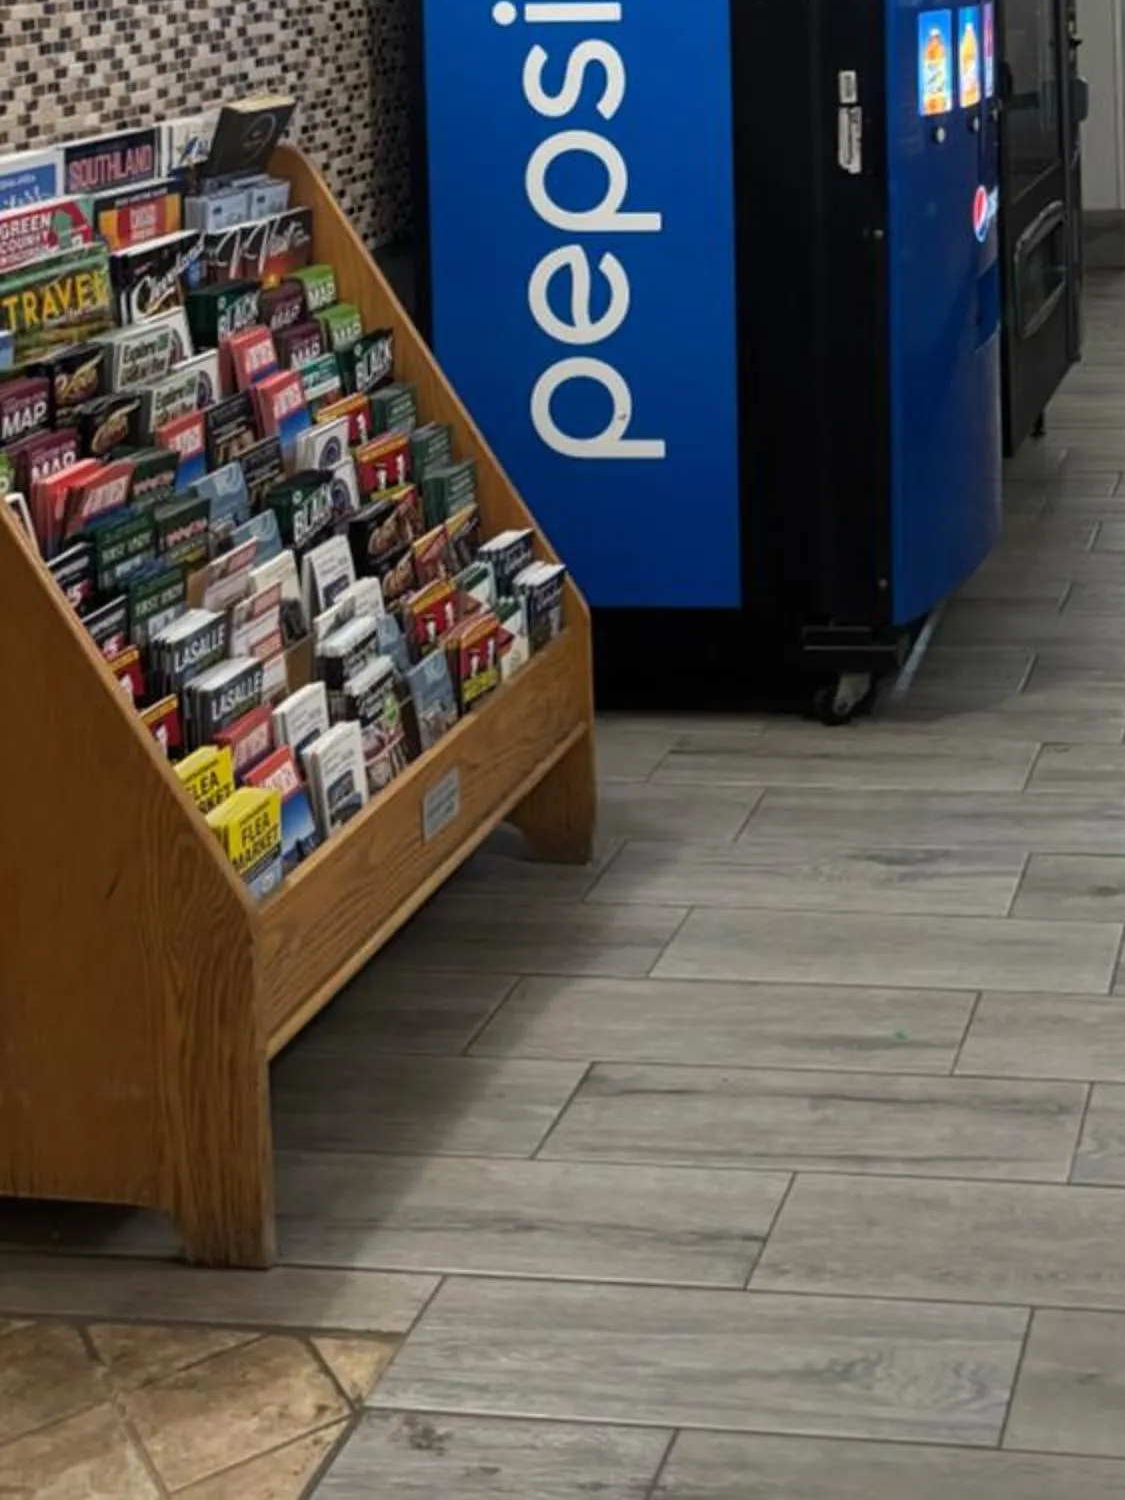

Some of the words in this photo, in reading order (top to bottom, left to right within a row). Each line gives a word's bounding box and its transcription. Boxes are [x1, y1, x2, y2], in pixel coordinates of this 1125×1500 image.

[68, 144, 153, 192] SOUTHLAND
[492, 0, 666, 459] pepsi
[2, 401, 48, 440] MAP
[174, 623, 226, 673] LASALLE
[211, 670, 262, 721] LASALLE
[241, 812, 270, 843] FLEA
